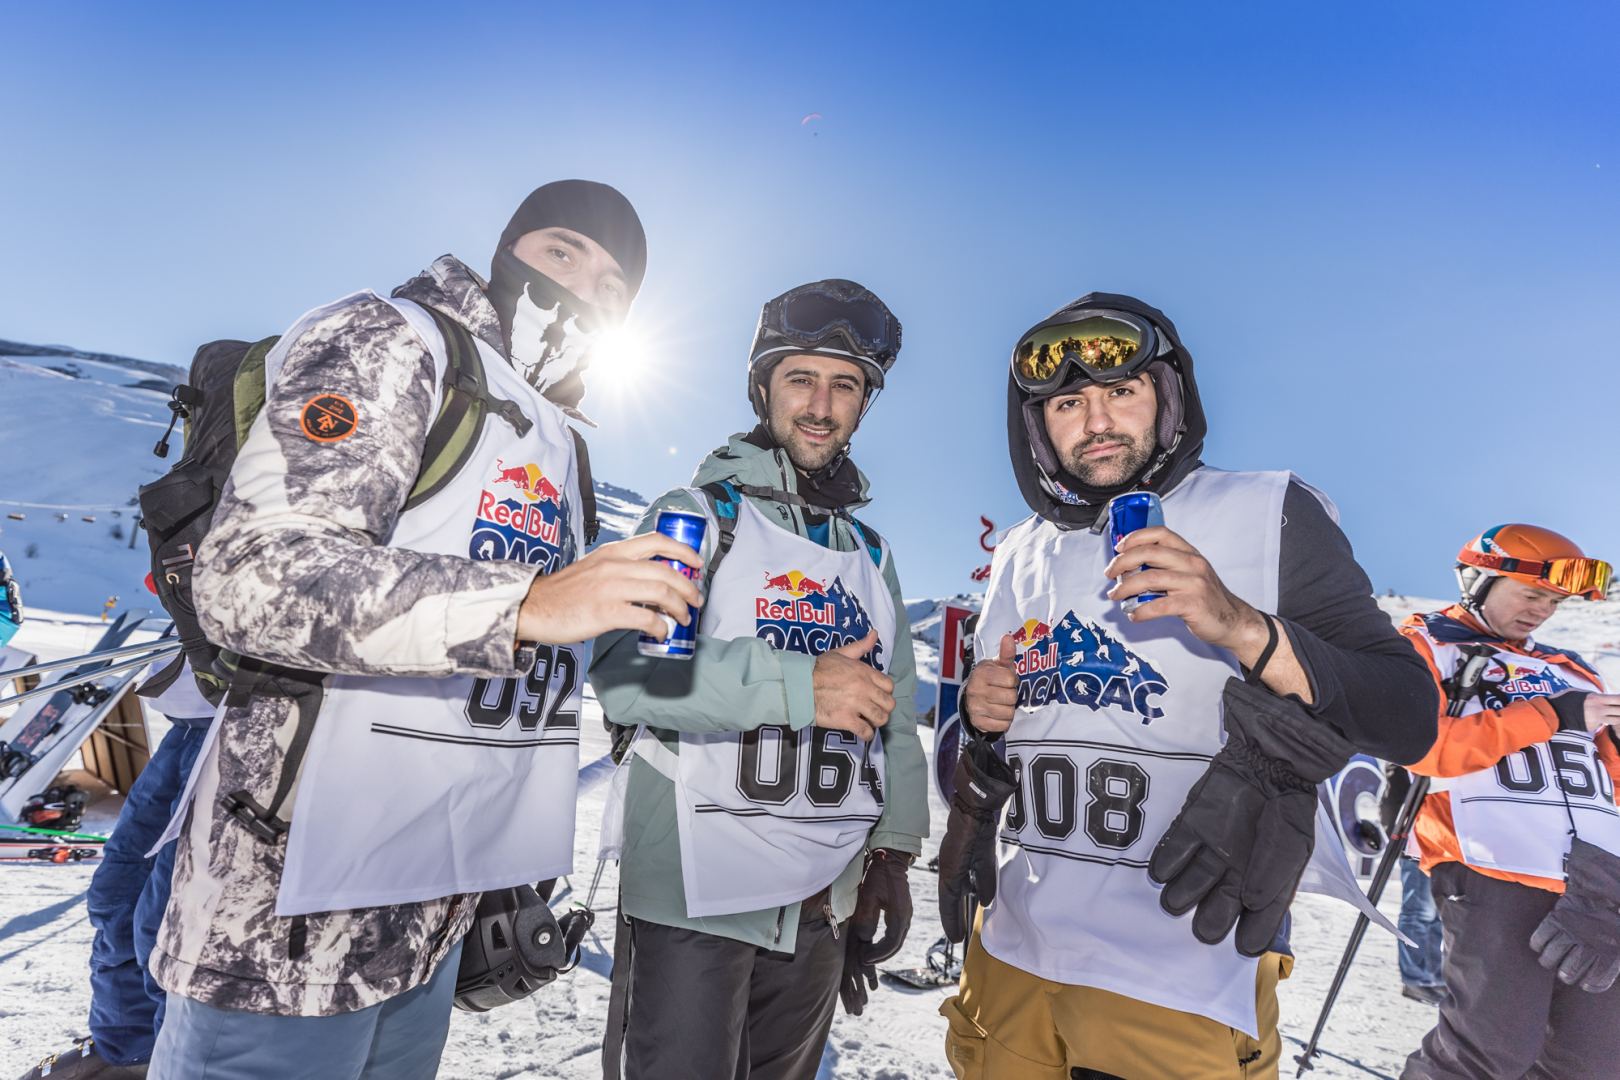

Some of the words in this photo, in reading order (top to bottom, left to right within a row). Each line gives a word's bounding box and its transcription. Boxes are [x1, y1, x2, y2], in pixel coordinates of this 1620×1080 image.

[476, 489, 528, 532] Red
[526, 506, 561, 547] Bull
[755, 597, 797, 622] Red
[798, 600, 836, 627] Bull
[1028, 642, 1059, 673] Bull
[463, 640, 580, 732] 092
[1518, 679, 1554, 695] Bull
